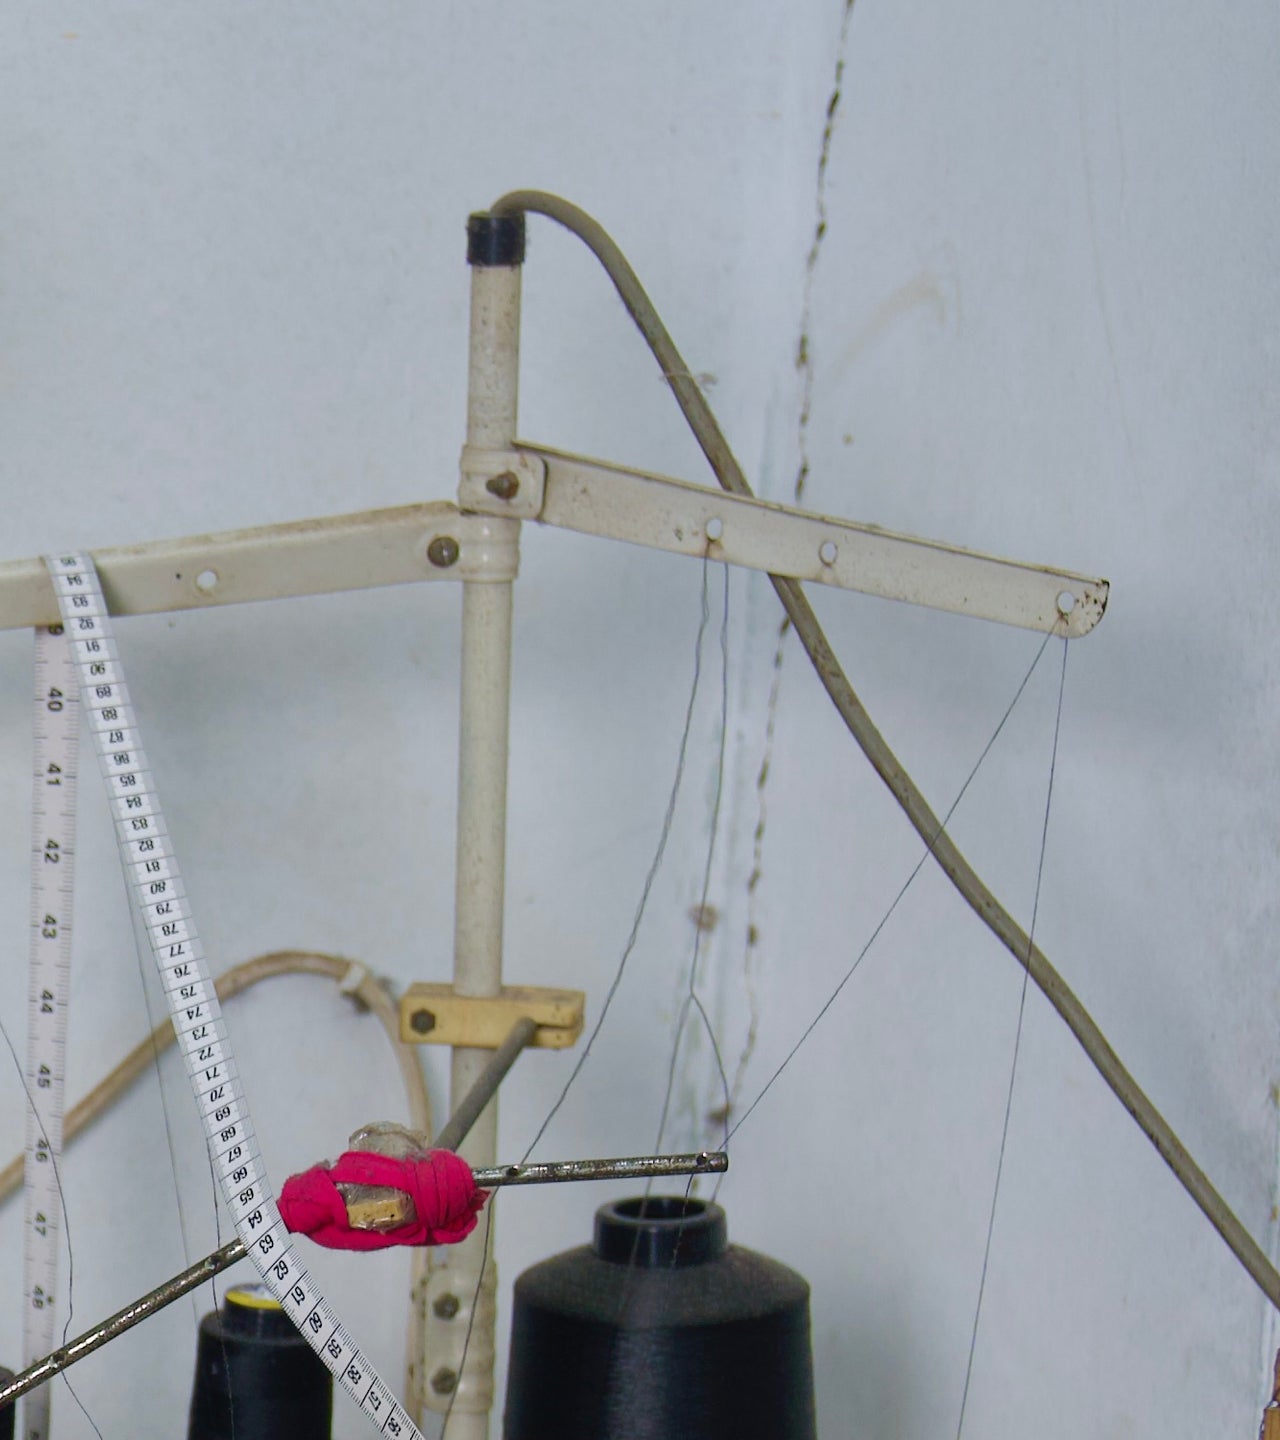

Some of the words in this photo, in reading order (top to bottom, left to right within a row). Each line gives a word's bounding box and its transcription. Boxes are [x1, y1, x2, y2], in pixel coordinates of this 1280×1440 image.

[67, 575, 82, 586] 94
[72, 596, 88, 608] 93
[79, 618, 94, 630] 92
[86, 640, 100, 652] 91
[90, 663, 105, 676] 90
[47, 686, 63, 712] 40
[96, 686, 112, 699] 89
[102, 708, 118, 721] 88
[109, 731, 124, 744] 87
[113, 752, 130, 766] 86
[46, 763, 61, 786] 41
[120, 774, 136, 787] 85
[126, 796, 142, 809] 84
[132, 818, 148, 831] 83
[44, 839, 60, 864] 42
[139, 839, 154, 853] 82
[145, 860, 161, 874] 81
[150, 881, 166, 895] 80
[156, 902, 173, 915] 79
[42, 914, 57, 939] 43
[162, 923, 179, 936] 78
[169, 944, 185, 957] 77
[174, 965, 191, 978] 76
[180, 985, 197, 1000] 75
[40, 989, 54, 1013] 44
[186, 1006, 203, 1020] 74
[192, 1026, 209, 1041] 73
[199, 1046, 215, 1061] 72
[37, 1064, 50, 1089] 45
[205, 1066, 220, 1081] 71
[210, 1086, 225, 1102] 70
[215, 1106, 231, 1122] 69
[221, 1126, 236, 1142] 68
[36, 1138, 48, 1163] 46
[228, 1146, 242, 1163] 67
[232, 1166, 248, 1184] 66
[239, 1187, 254, 1206] 65
[34, 1212, 46, 1237] 47
[247, 1210, 263, 1229] 64
[259, 1233, 274, 1254] 63
[273, 1260, 289, 1280] 62
[291, 1286, 306, 1306] 61
[308, 1312, 323, 1333] 60
[327, 1339, 342, 1359] 59
[347, 1364, 362, 1385] 58
[368, 1391, 382, 1411] 57
